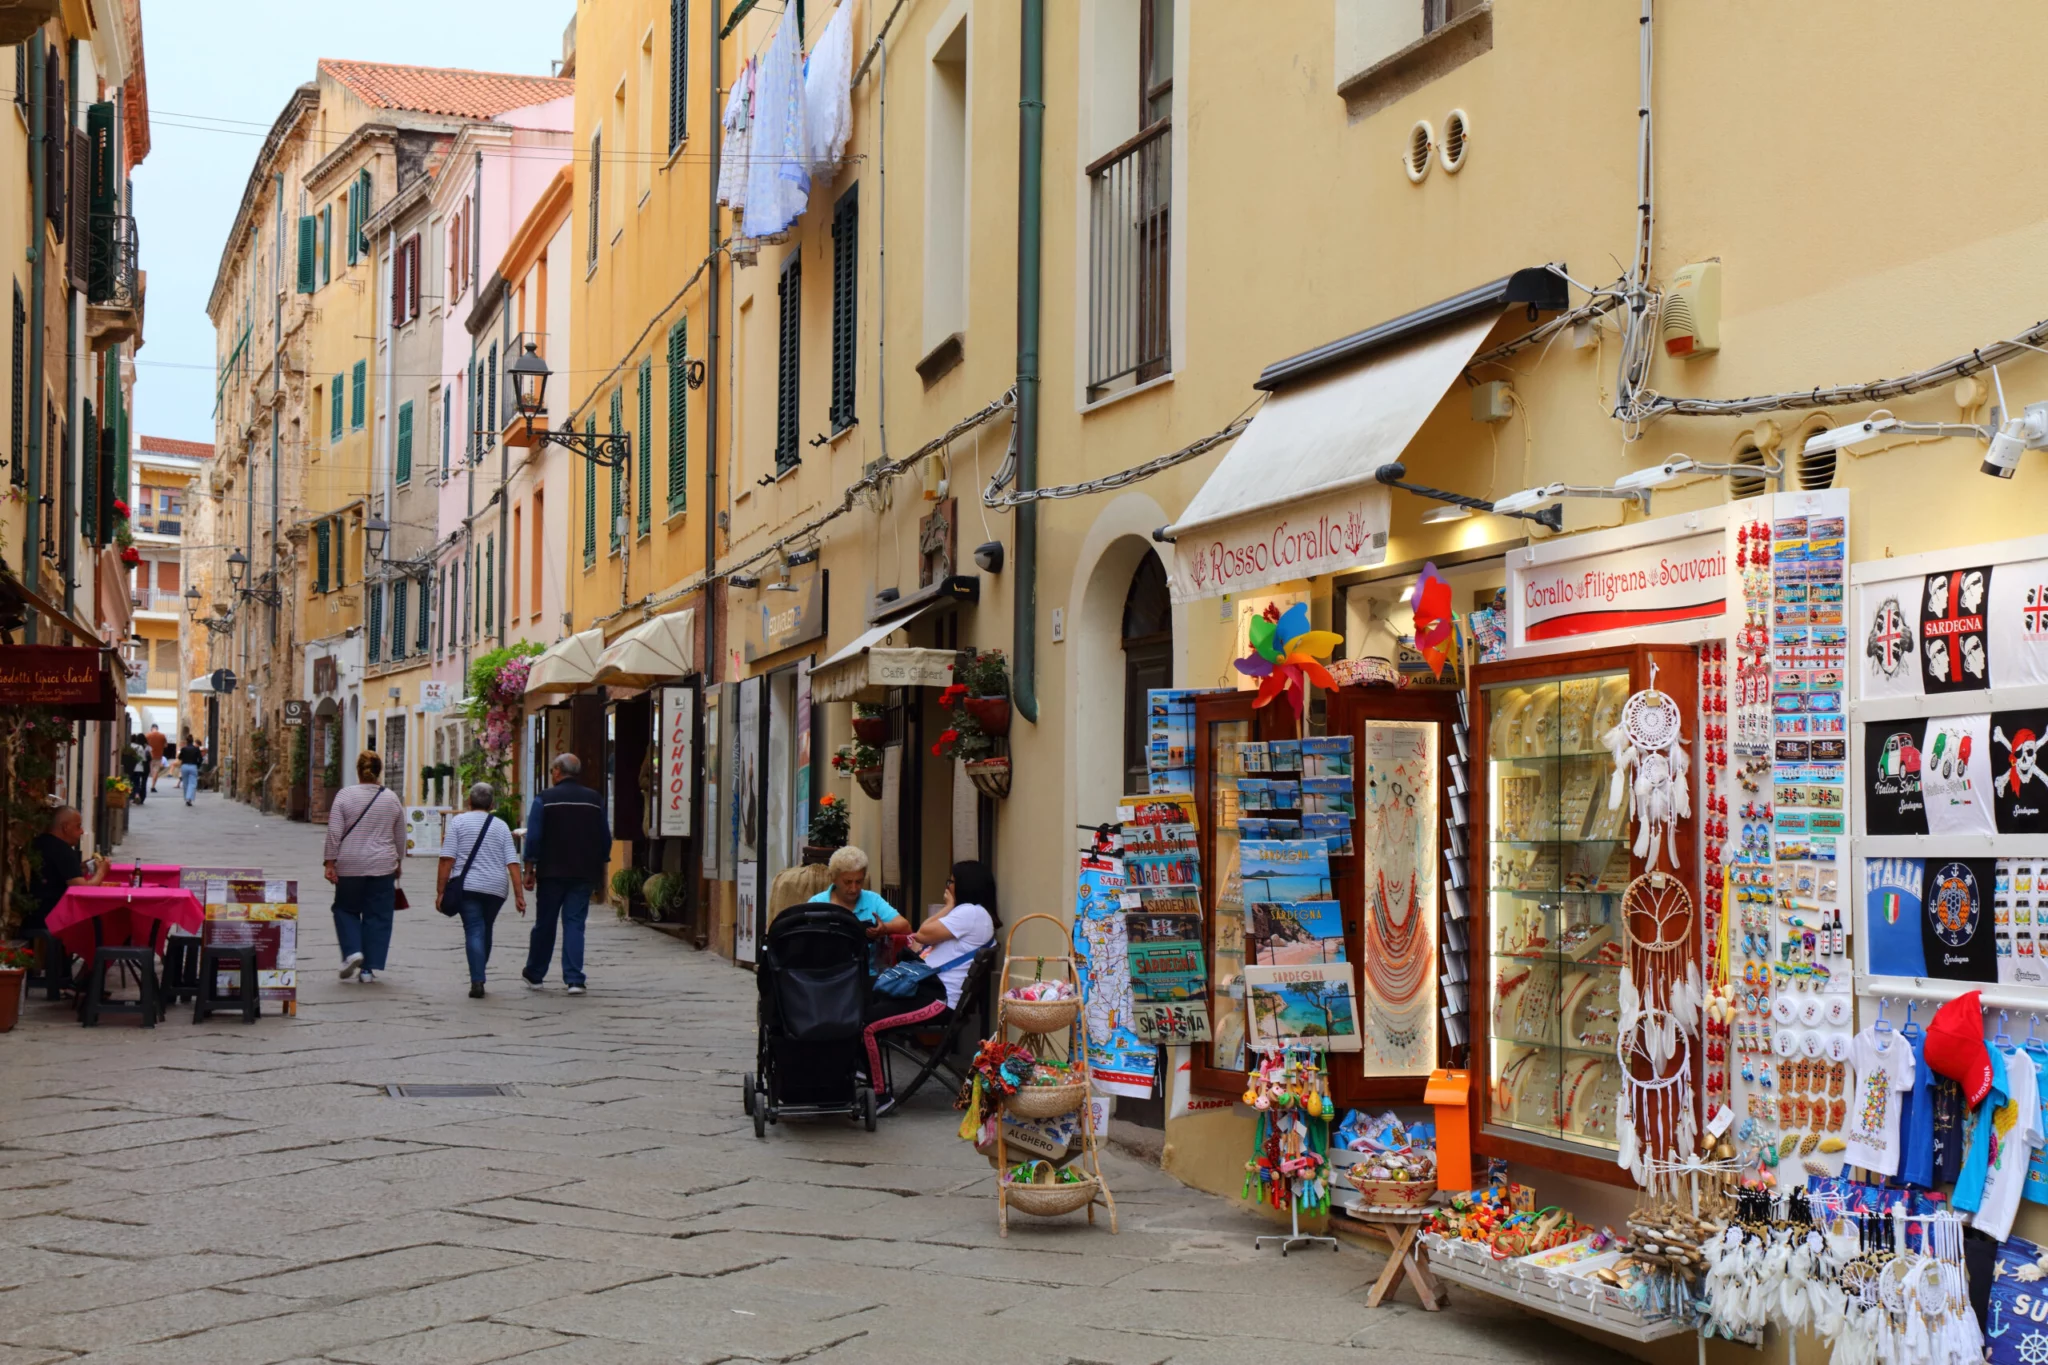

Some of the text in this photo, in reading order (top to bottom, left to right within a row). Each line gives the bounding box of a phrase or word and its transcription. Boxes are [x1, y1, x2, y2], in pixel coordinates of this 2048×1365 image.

[1210, 515, 1342, 585] Rosso Corallo
[1525, 578, 1574, 609] Corallo
[1584, 570, 1647, 602] Filigrana
[1925, 617, 1983, 636] SARDEGNA
[0, 667, 30, 684] odotti
[62, 666, 93, 684] Sardi
[908, 666, 943, 681] Gilbert
[426, 683, 441, 691] AZ
[670, 712, 685, 811] ICHNOS
[1874, 780, 1915, 795] Italian Style
[1776, 792, 1805, 800] SANA
[1811, 792, 1840, 803] SANA
[1898, 799, 1923, 814] Sardegna
[2012, 804, 2039, 817] Sardegna
[1132, 838, 1189, 855] SARDEGNA
[1259, 849, 1309, 860] SARDEGNA
[1867, 858, 1922, 902] ITALIA
[1148, 898, 1198, 913] SARDEGNA
[1270, 909, 1322, 920] SARDEGNA
[1135, 957, 1198, 974] SARDEGNA
[1943, 953, 1970, 965] Sardegna
[1272, 969, 1324, 983] SARDEGNA
[2014, 968, 2041, 981] Sardegna
[1140, 1014, 1205, 1033] SANA
[1971, 1065, 1991, 1103] SARDEGNA
[1008, 1128, 1054, 1152] ALGHERO
